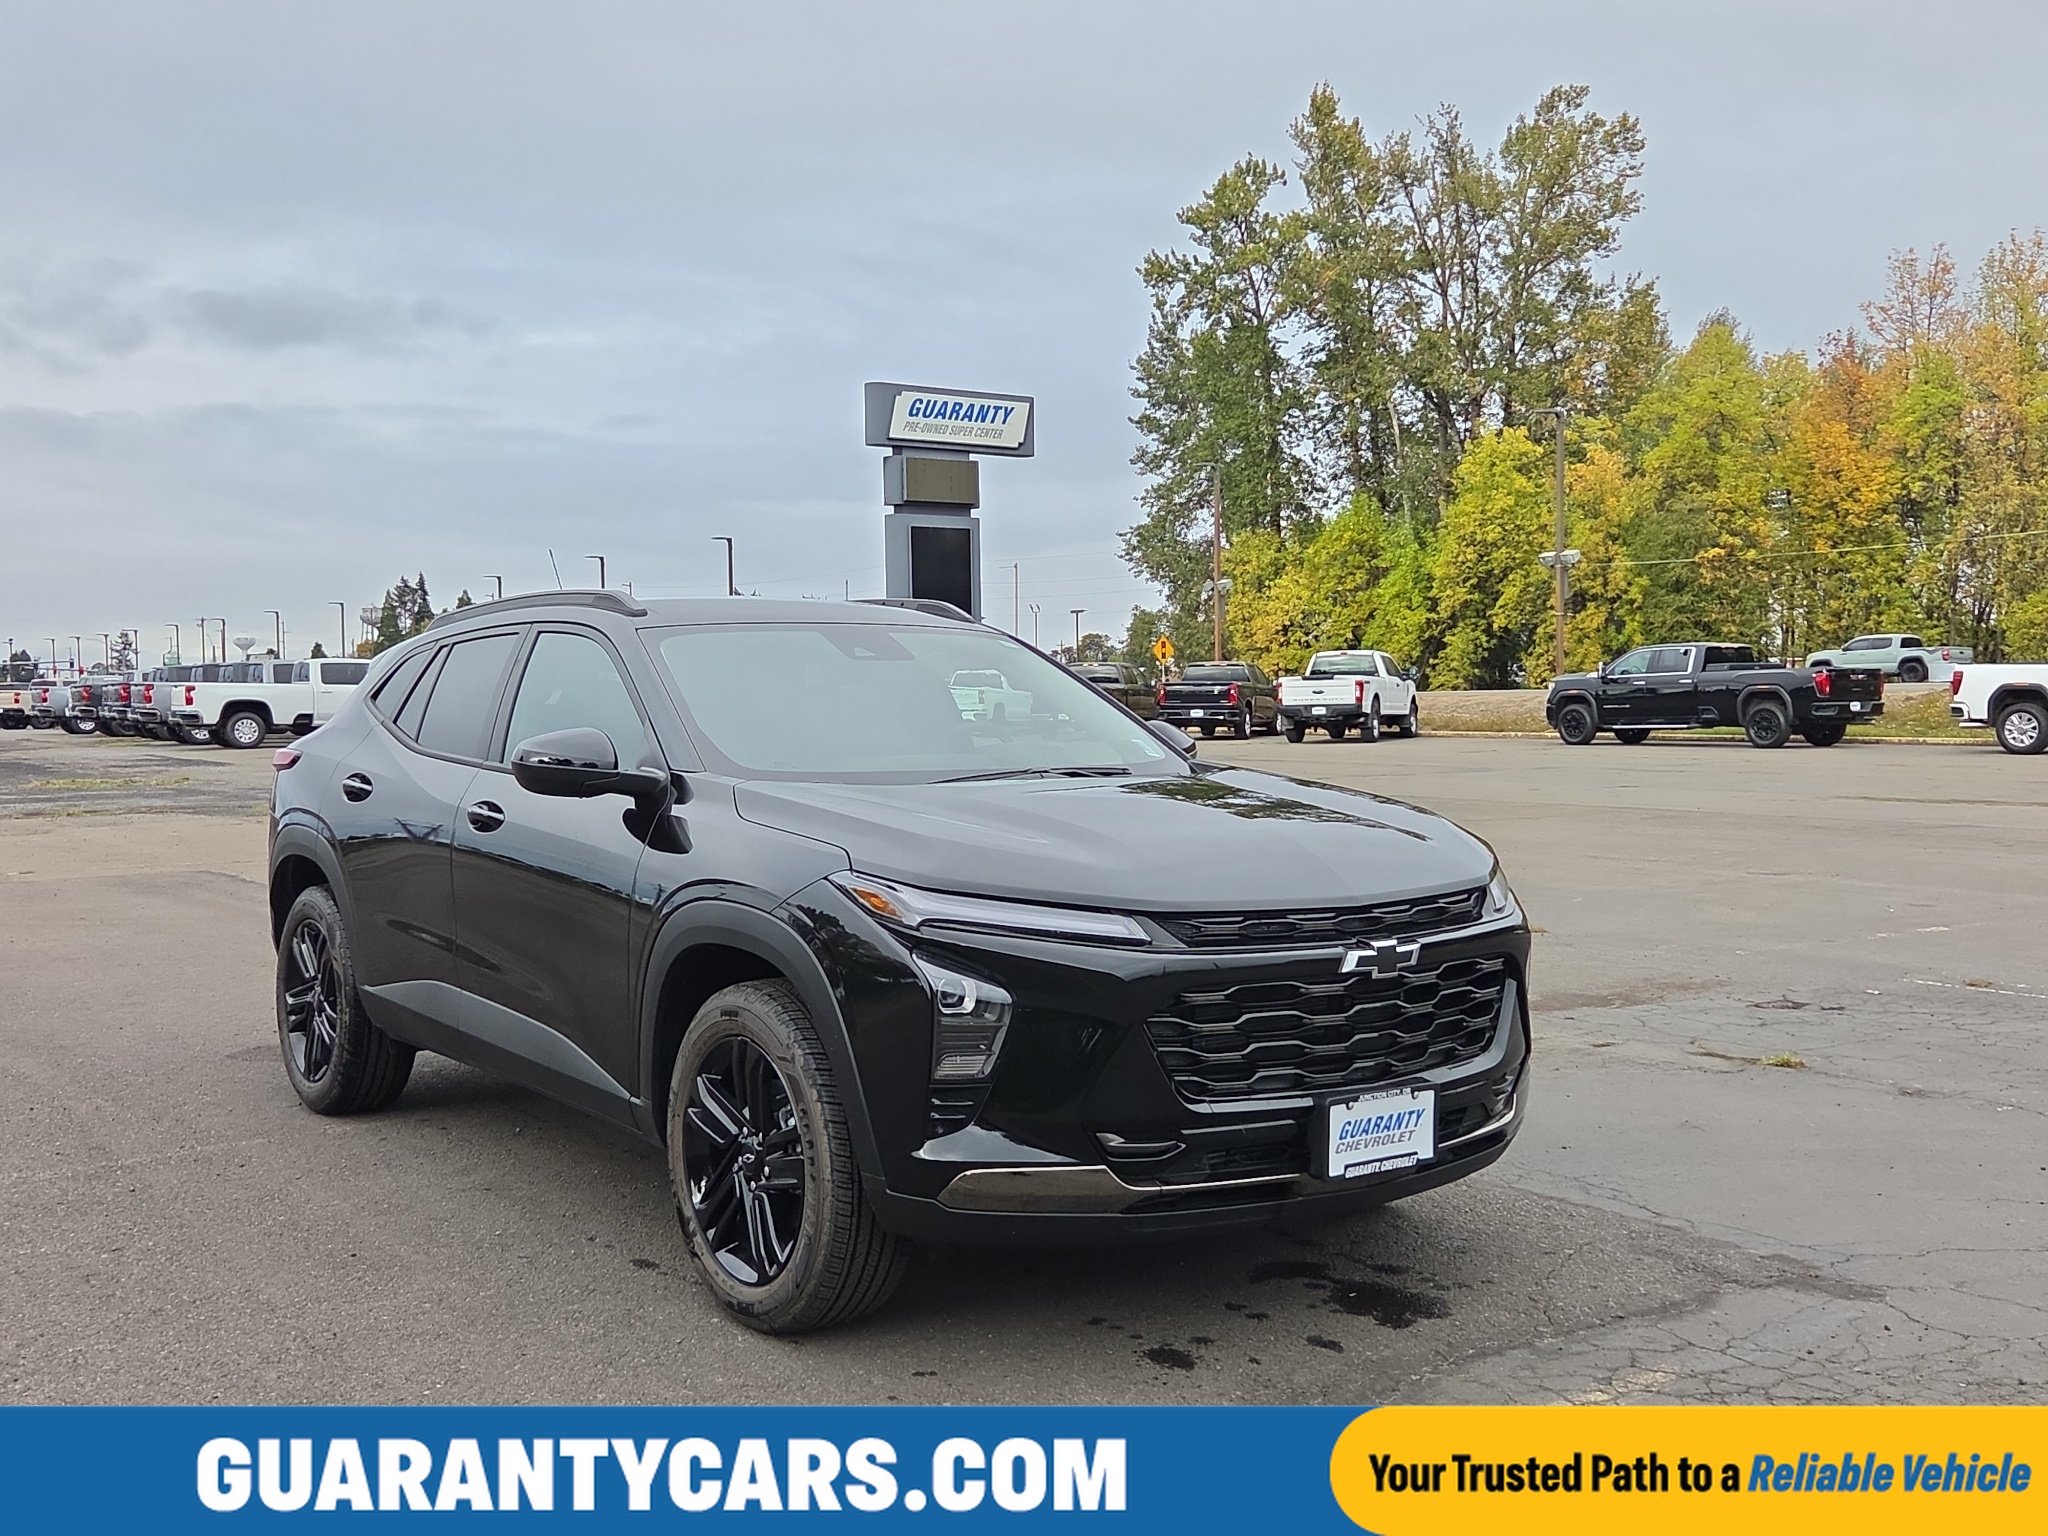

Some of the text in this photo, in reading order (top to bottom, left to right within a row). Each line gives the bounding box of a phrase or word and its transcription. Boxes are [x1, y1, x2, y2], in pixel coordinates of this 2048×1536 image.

[908, 398, 1015, 425] GUARANTY
[903, 421, 1004, 439] PRE-OWNED SUPER CENTER
[1358, 1092, 1387, 1102] JUNCTION
[1339, 1108, 1426, 1141] GUARANTY
[1335, 1130, 1417, 1154] CHEVROLET
[1381, 1155, 1419, 1171] CHEVROLET
